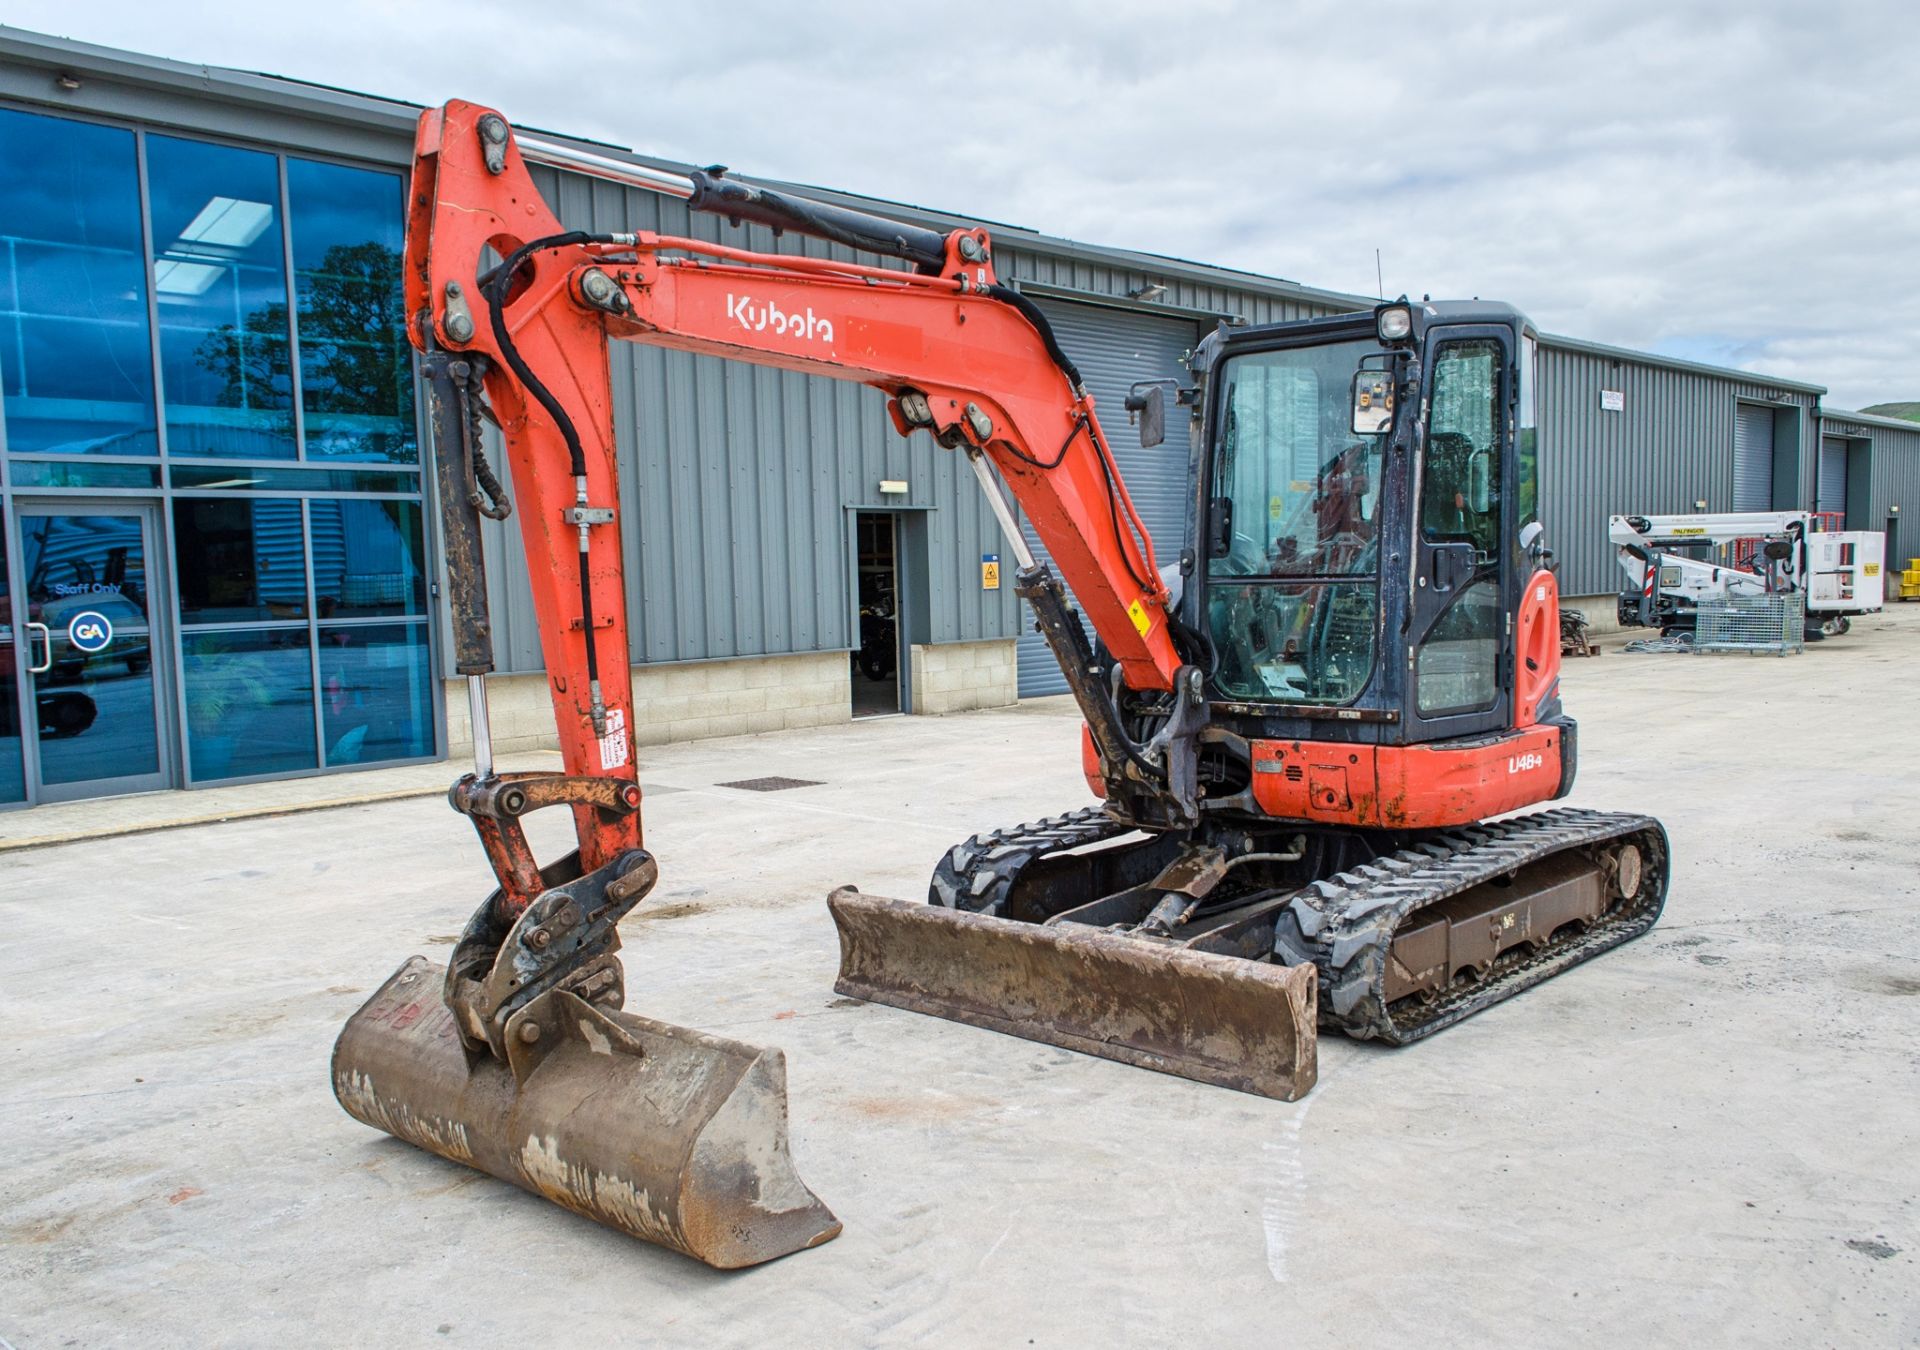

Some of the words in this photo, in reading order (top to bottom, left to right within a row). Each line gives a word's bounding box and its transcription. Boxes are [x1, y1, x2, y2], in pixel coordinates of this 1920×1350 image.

[727, 293, 834, 343] Kubota
[55, 583, 89, 595] Staff
[92, 582, 121, 595] Only
